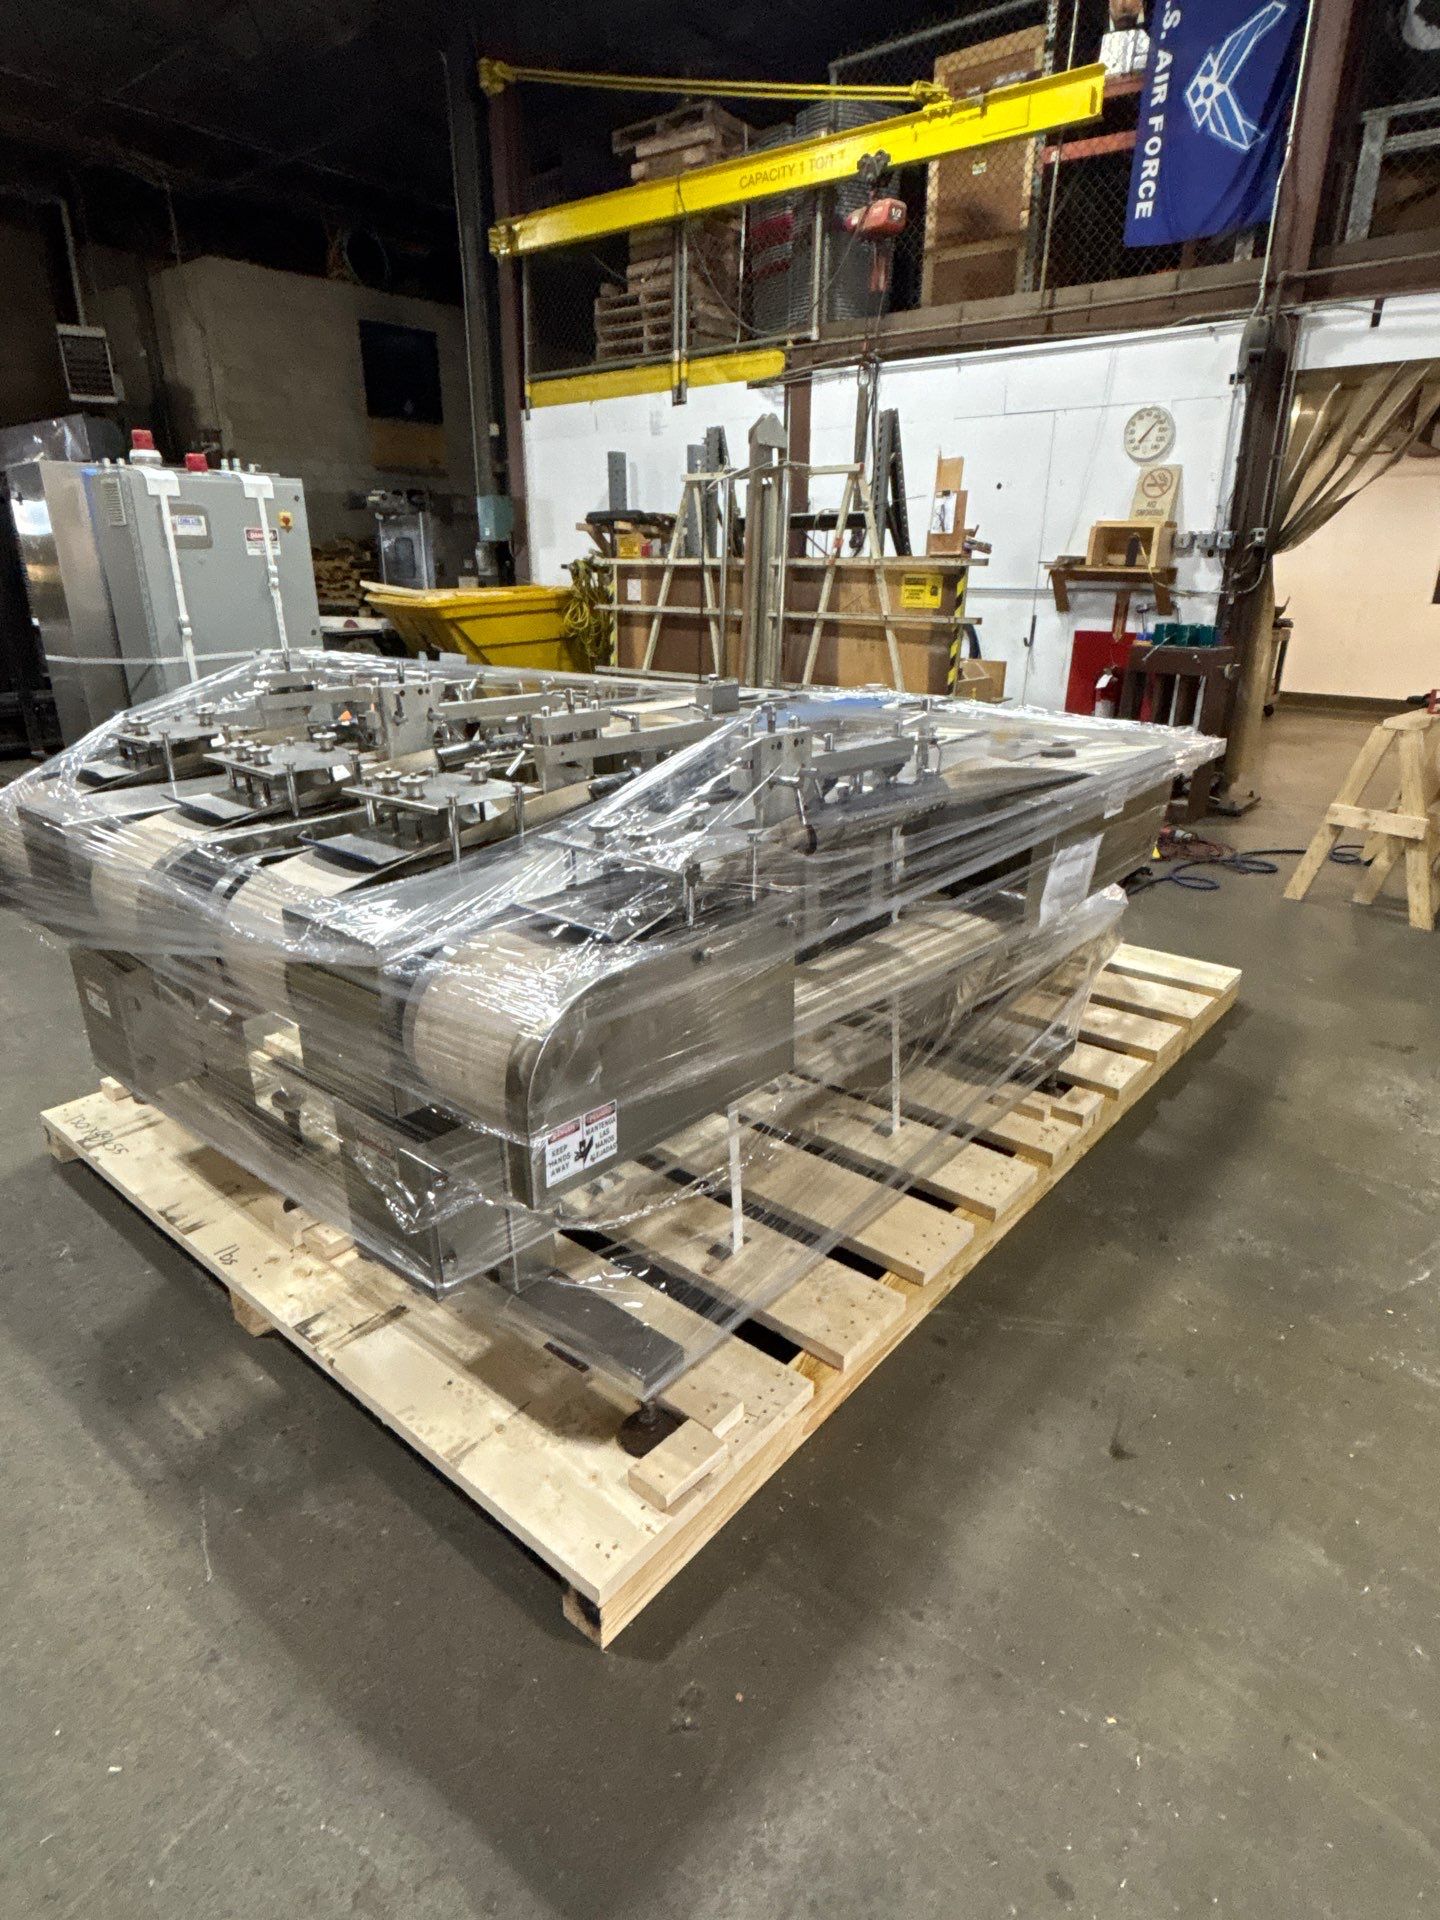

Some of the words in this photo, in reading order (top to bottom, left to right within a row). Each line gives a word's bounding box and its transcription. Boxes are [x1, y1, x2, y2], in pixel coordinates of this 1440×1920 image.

[1150, 49, 1173, 108] AIR
[1134, 113, 1164, 220] FORCE
[739, 164, 796, 190] CAPACITY
[585, 1117, 616, 1136] MANTENGA
[599, 1128, 610, 1139] LAS
[595, 1135, 615, 1149] MANOS
[551, 1162, 570, 1177] AWAY
[213, 1243, 240, 1265] lbs
